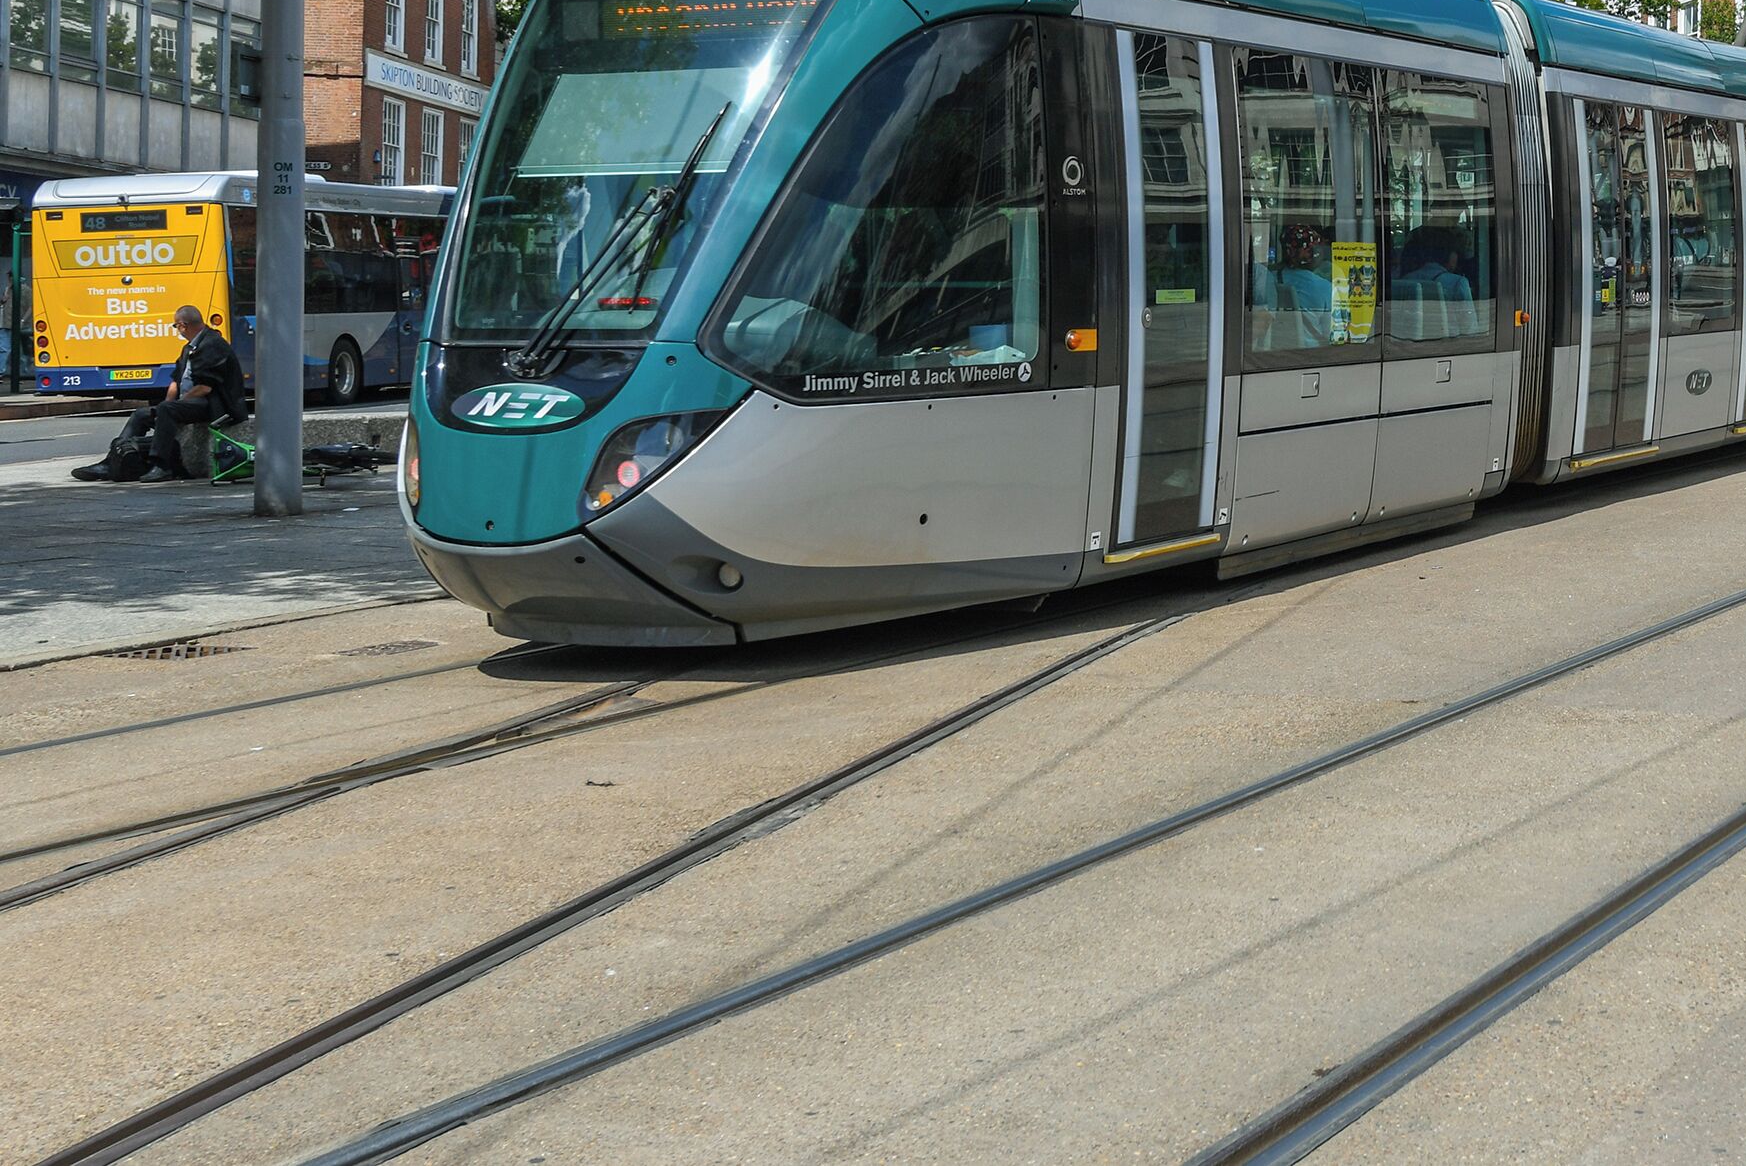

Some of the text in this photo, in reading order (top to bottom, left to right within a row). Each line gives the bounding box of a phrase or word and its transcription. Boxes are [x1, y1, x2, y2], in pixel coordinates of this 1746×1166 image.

[381, 63, 483, 107] SKIPTON BUILDING SOCIETY
[273, 162, 293, 171] OM
[273, 185, 292, 194] 281
[84, 217, 106, 230] 48
[75, 239, 175, 267] outdo
[87, 287, 104, 295] The
[157, 285, 165, 293] in
[107, 297, 148, 314] Bus
[63, 376, 81, 386] 213
[802, 365, 1015, 392] Jimmy Sirrel & Jack Wheeler
[1689, 373, 1710, 389] NET
[467, 392, 570, 418] NET
